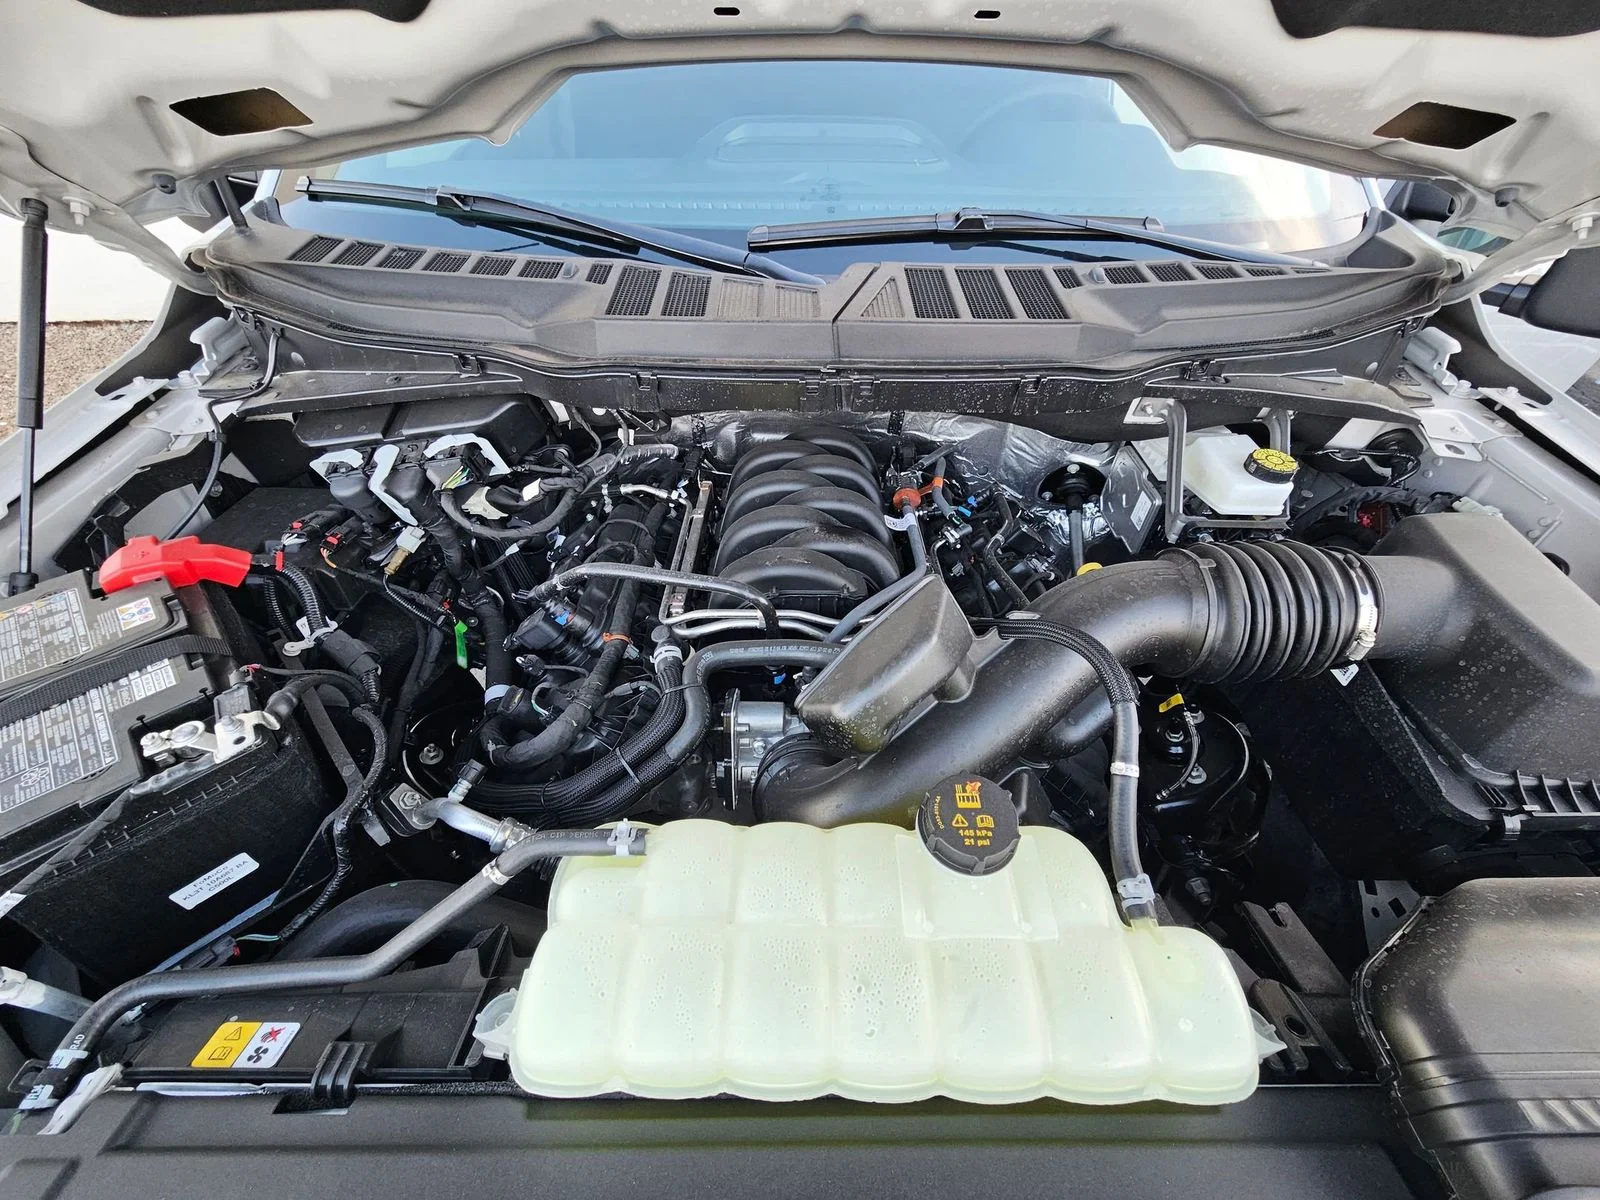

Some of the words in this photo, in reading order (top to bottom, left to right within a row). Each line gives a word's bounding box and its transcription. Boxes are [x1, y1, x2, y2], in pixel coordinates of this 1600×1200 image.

[958, 829, 975, 837] 145
[976, 829, 993, 837] kPa
[964, 838, 975, 846] 21
[977, 838, 991, 848] psi
[70, 1034, 85, 1050] RAD
